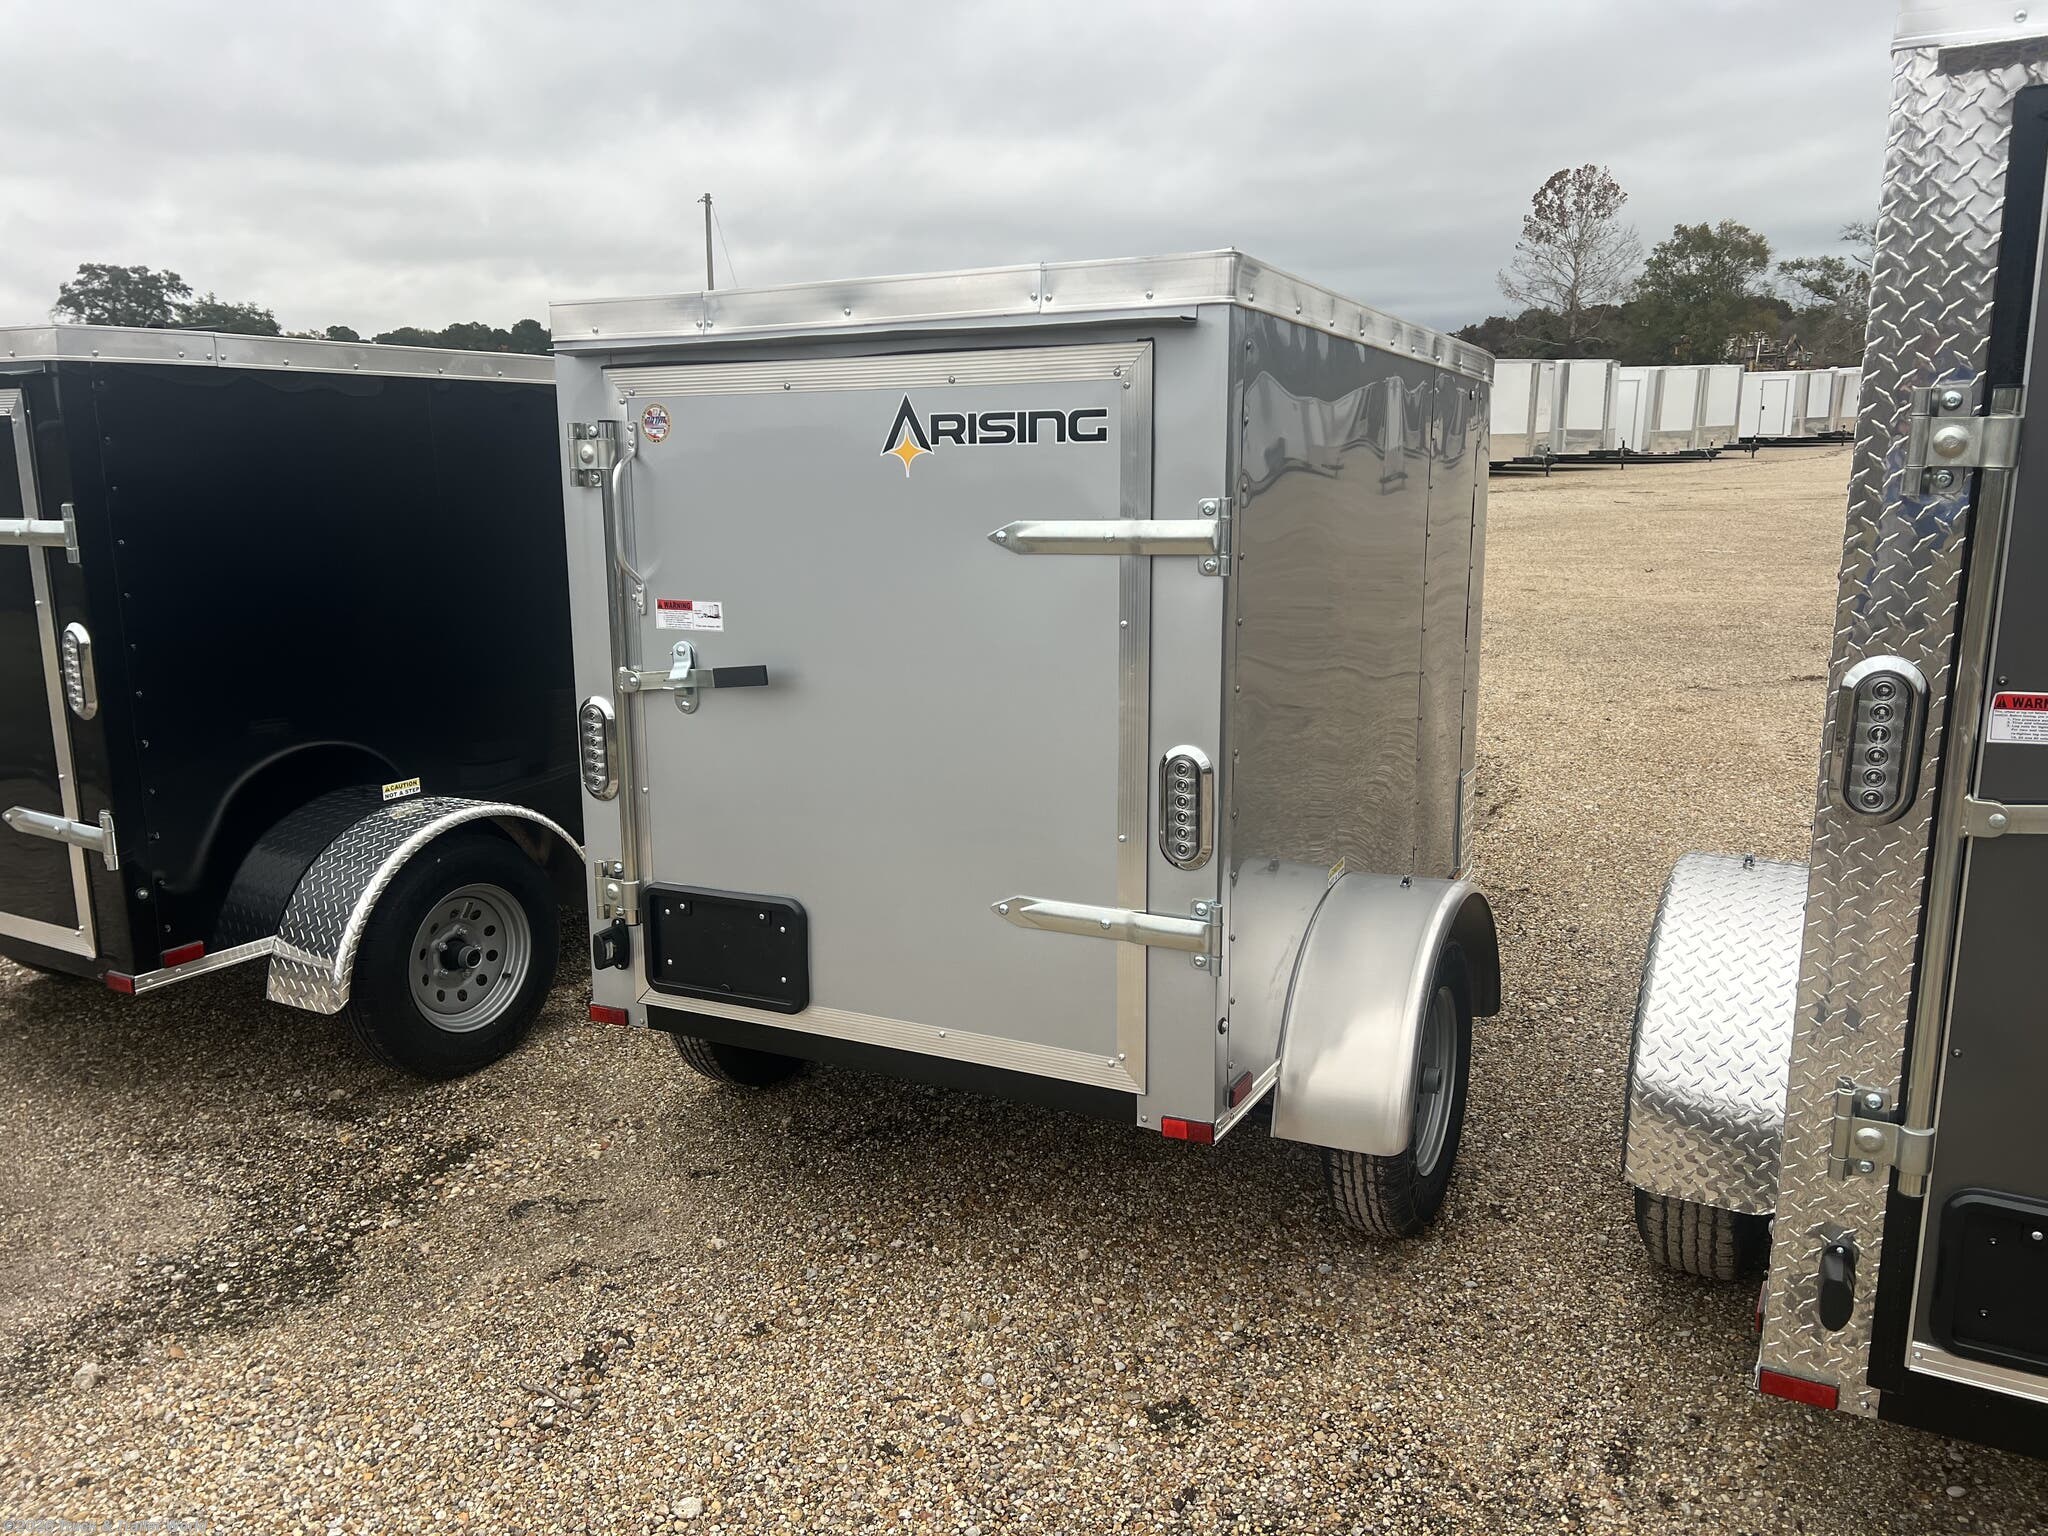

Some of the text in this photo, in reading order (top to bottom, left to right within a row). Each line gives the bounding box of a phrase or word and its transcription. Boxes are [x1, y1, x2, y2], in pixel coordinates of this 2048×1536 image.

[880, 392, 1109, 456] ARISING
[663, 600, 691, 610] WARNING
[390, 780, 418, 791] CAUTION
[384, 791, 398, 799] NOT
[404, 786, 420, 795] STEP
